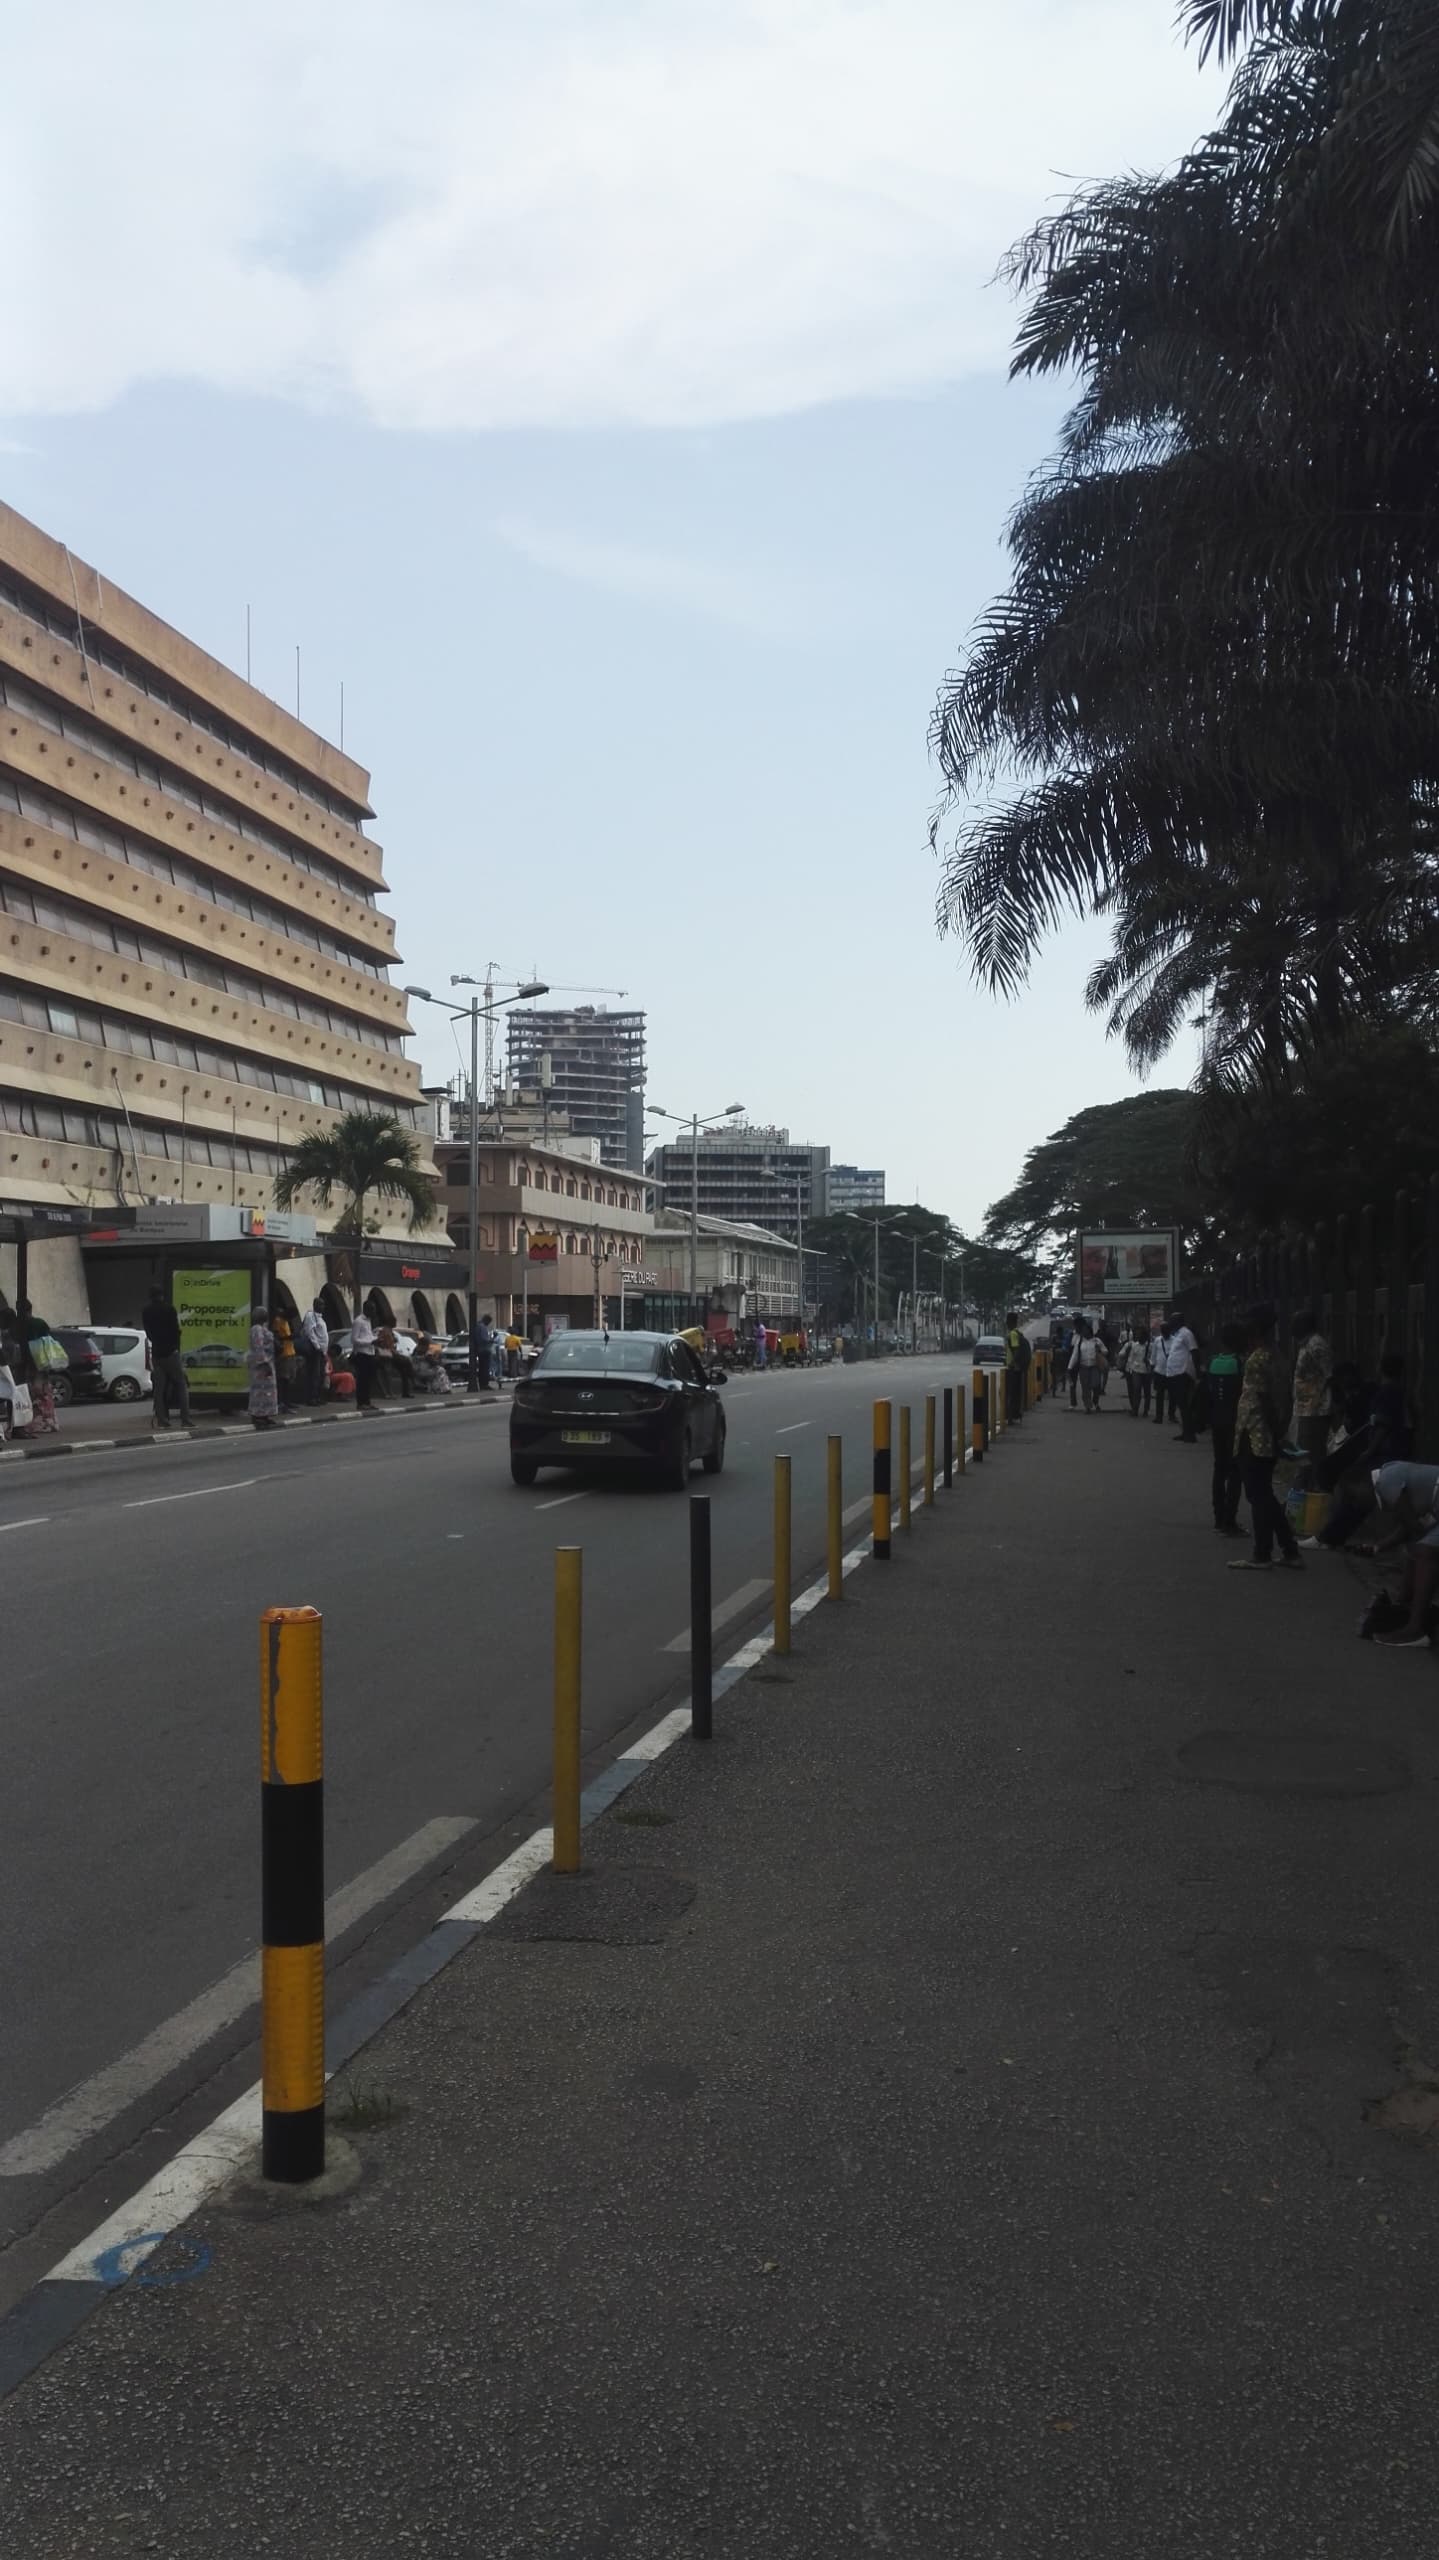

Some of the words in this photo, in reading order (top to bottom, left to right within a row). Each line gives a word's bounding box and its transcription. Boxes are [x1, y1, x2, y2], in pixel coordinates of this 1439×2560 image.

[402, 1265, 421, 1280] Orange
[180, 1303, 236, 1316] Proposez
[180, 1317, 213, 1327] votre
[215, 1317, 238, 1329] prix
